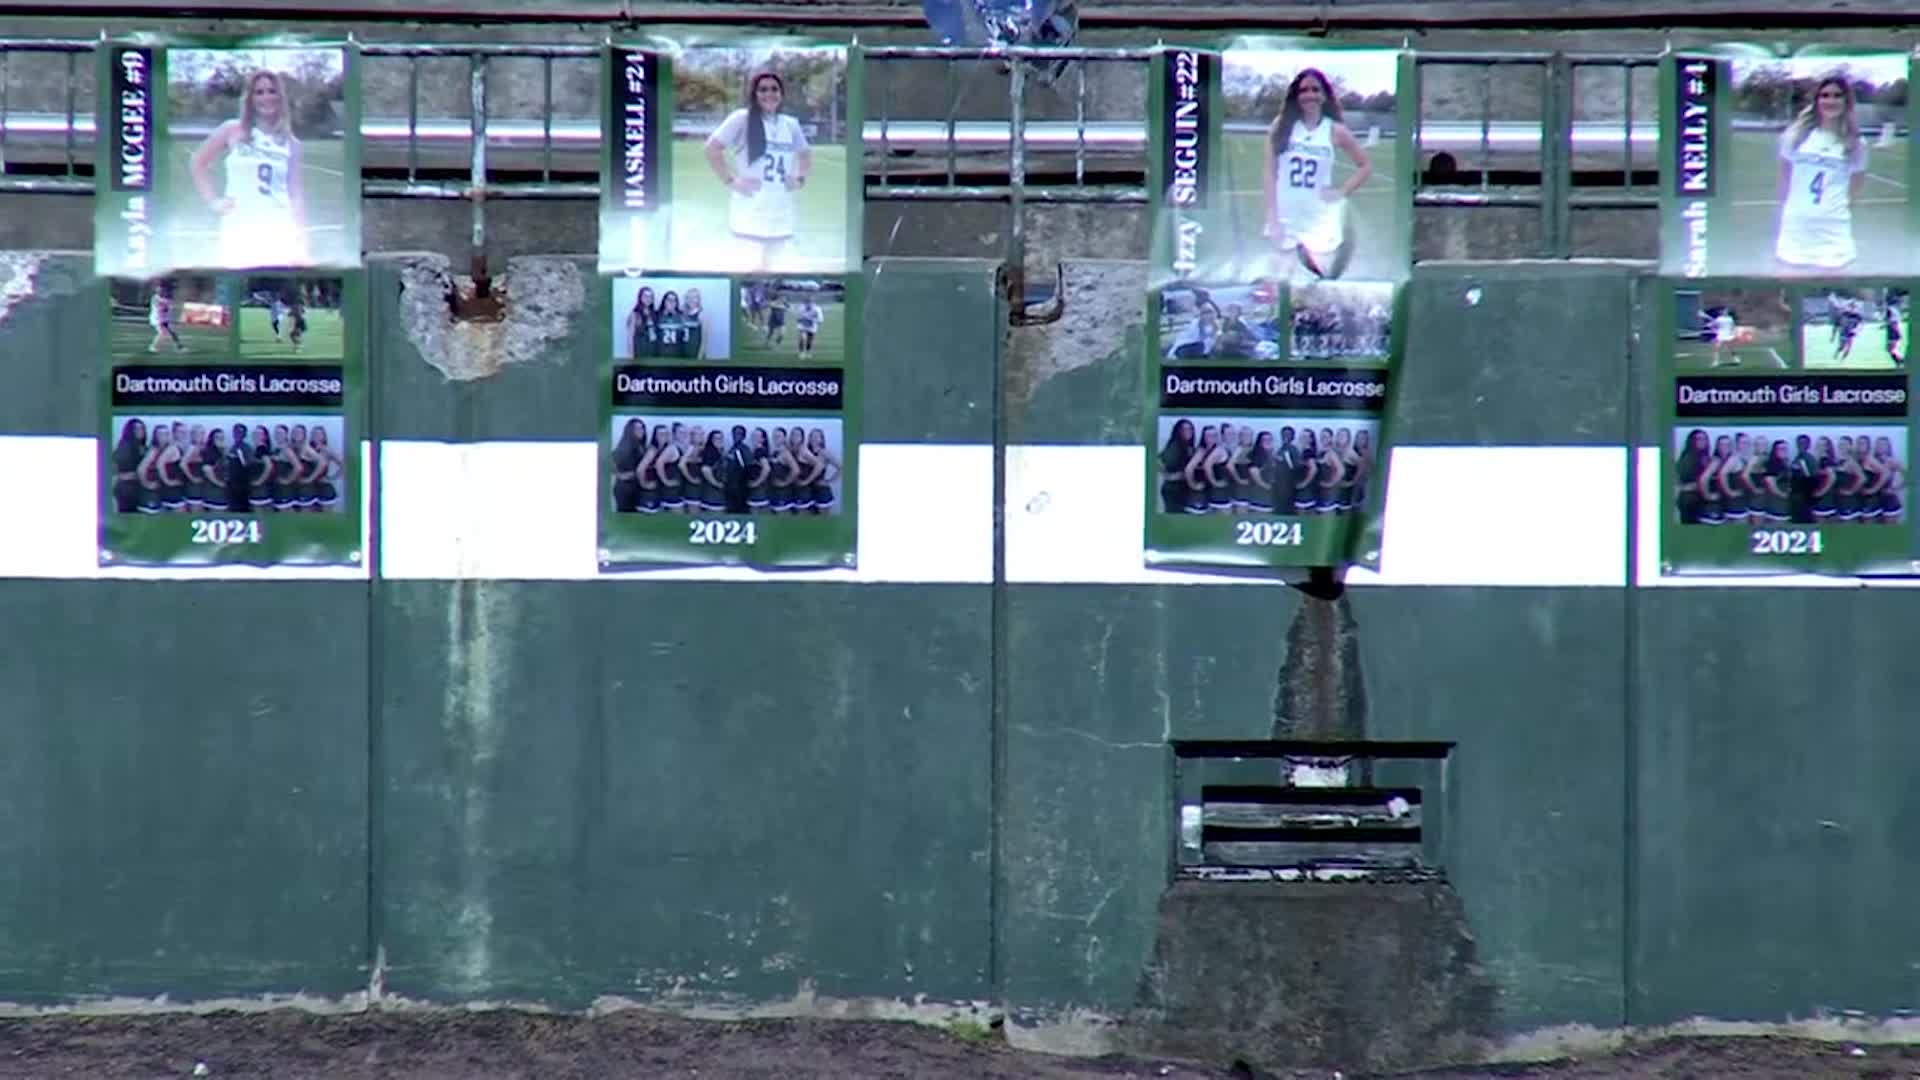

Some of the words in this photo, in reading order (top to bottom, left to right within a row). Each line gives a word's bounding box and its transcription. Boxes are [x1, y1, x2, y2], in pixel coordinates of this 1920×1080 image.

[121, 91, 146, 185] MCGEE
[1683, 102, 1708, 190] KELLY
[624, 98, 645, 208] HASKELL
[258, 163, 272, 195] 9
[763, 153, 786, 183] 24
[1290, 156, 1318, 188] 22
[1809, 171, 1825, 204] 4
[1682, 202, 1708, 278] Sarah
[116, 373, 213, 393] Dartmouth
[216, 374, 256, 393] Girls
[260, 375, 341, 393] Lacrosse
[617, 374, 711, 393] Dartmouth
[715, 375, 754, 394] Girls
[758, 377, 839, 396] Lacrosse
[1166, 375, 1261, 395] Dartmouth
[1265, 376, 1304, 395] Girls
[1308, 377, 1384, 397] Lacrosse
[1679, 385, 1776, 404] Dartmouth
[1780, 384, 1819, 403] Girls
[1823, 385, 1905, 404] Lacrosse
[191, 520, 262, 543] 2024
[689, 520, 757, 544] 2024
[1236, 521, 1303, 545] 2024
[1753, 531, 1823, 554] 2024
